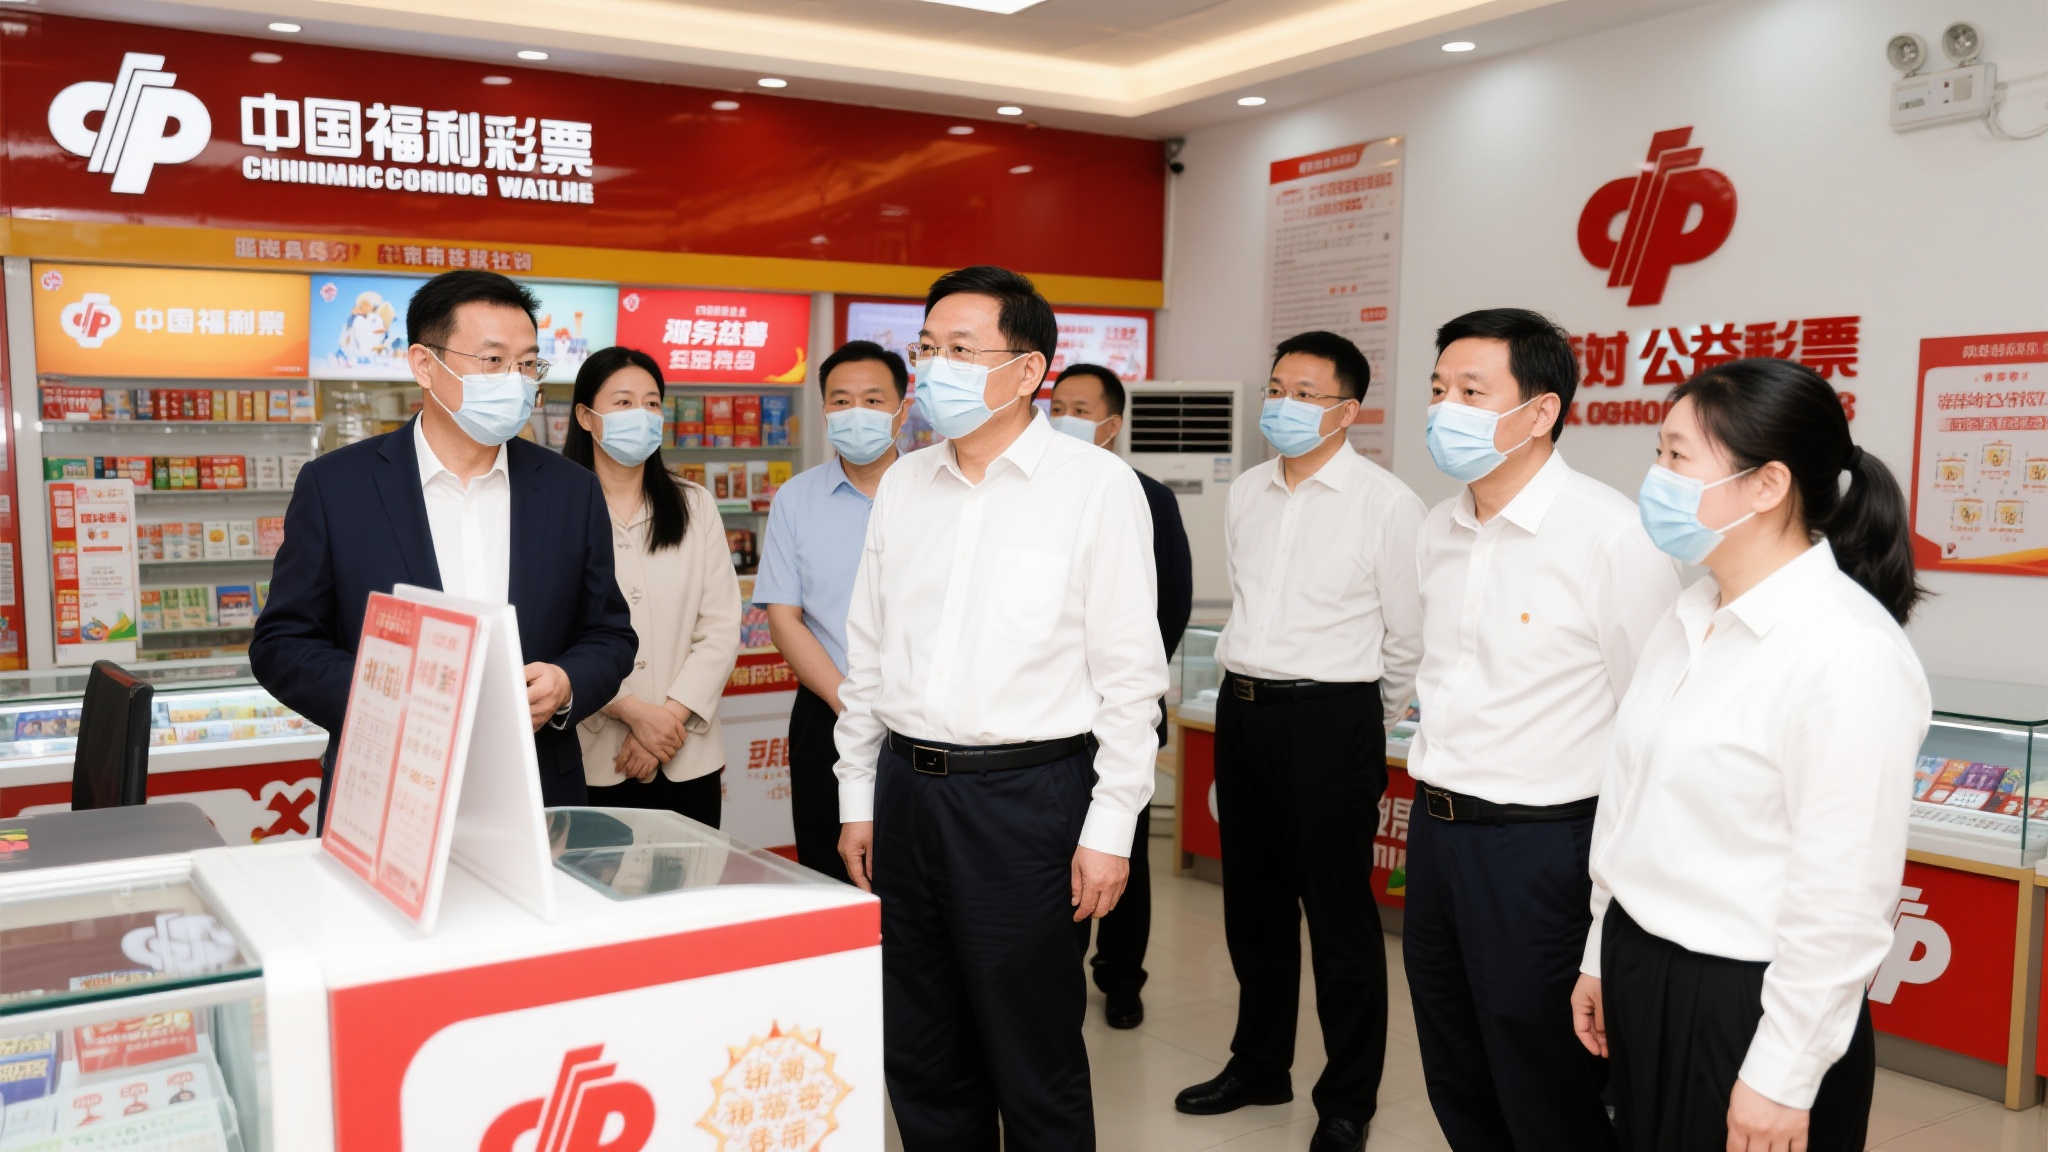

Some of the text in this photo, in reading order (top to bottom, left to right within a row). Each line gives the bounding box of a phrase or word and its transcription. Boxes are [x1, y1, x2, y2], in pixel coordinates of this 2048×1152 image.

[240, 92, 594, 177] 中国福利彩票
